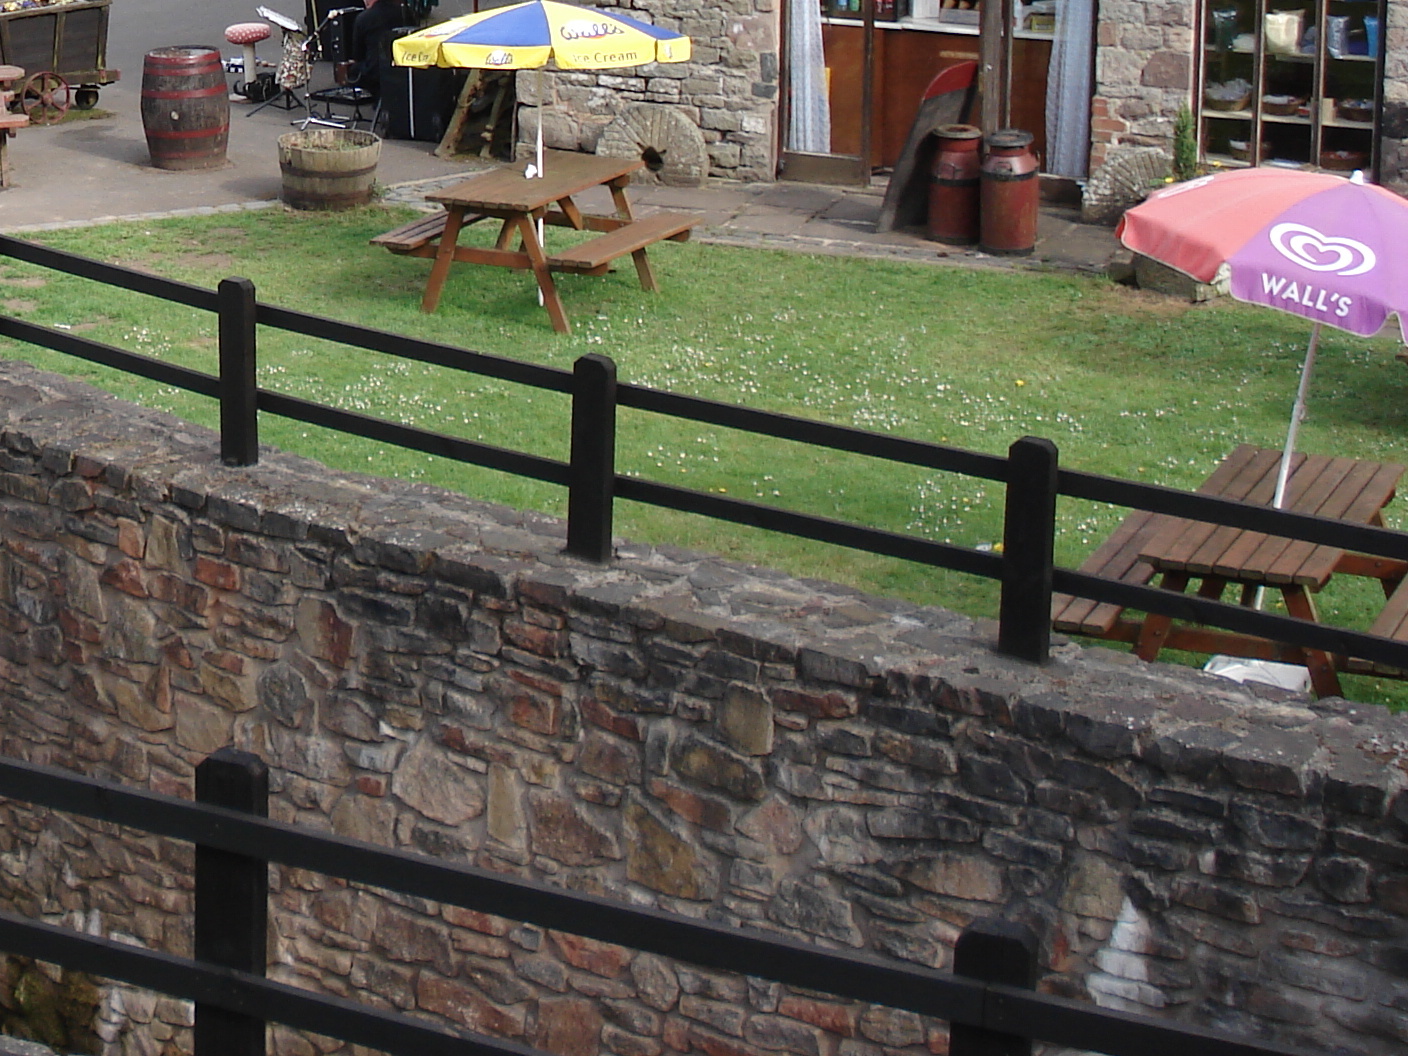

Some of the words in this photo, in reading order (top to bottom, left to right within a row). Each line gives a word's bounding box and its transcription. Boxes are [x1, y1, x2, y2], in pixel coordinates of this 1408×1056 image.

[560, 22, 625, 40] Wall's
[594, 51, 638, 63] Cream
[1261, 272, 1353, 317] WALL'S
